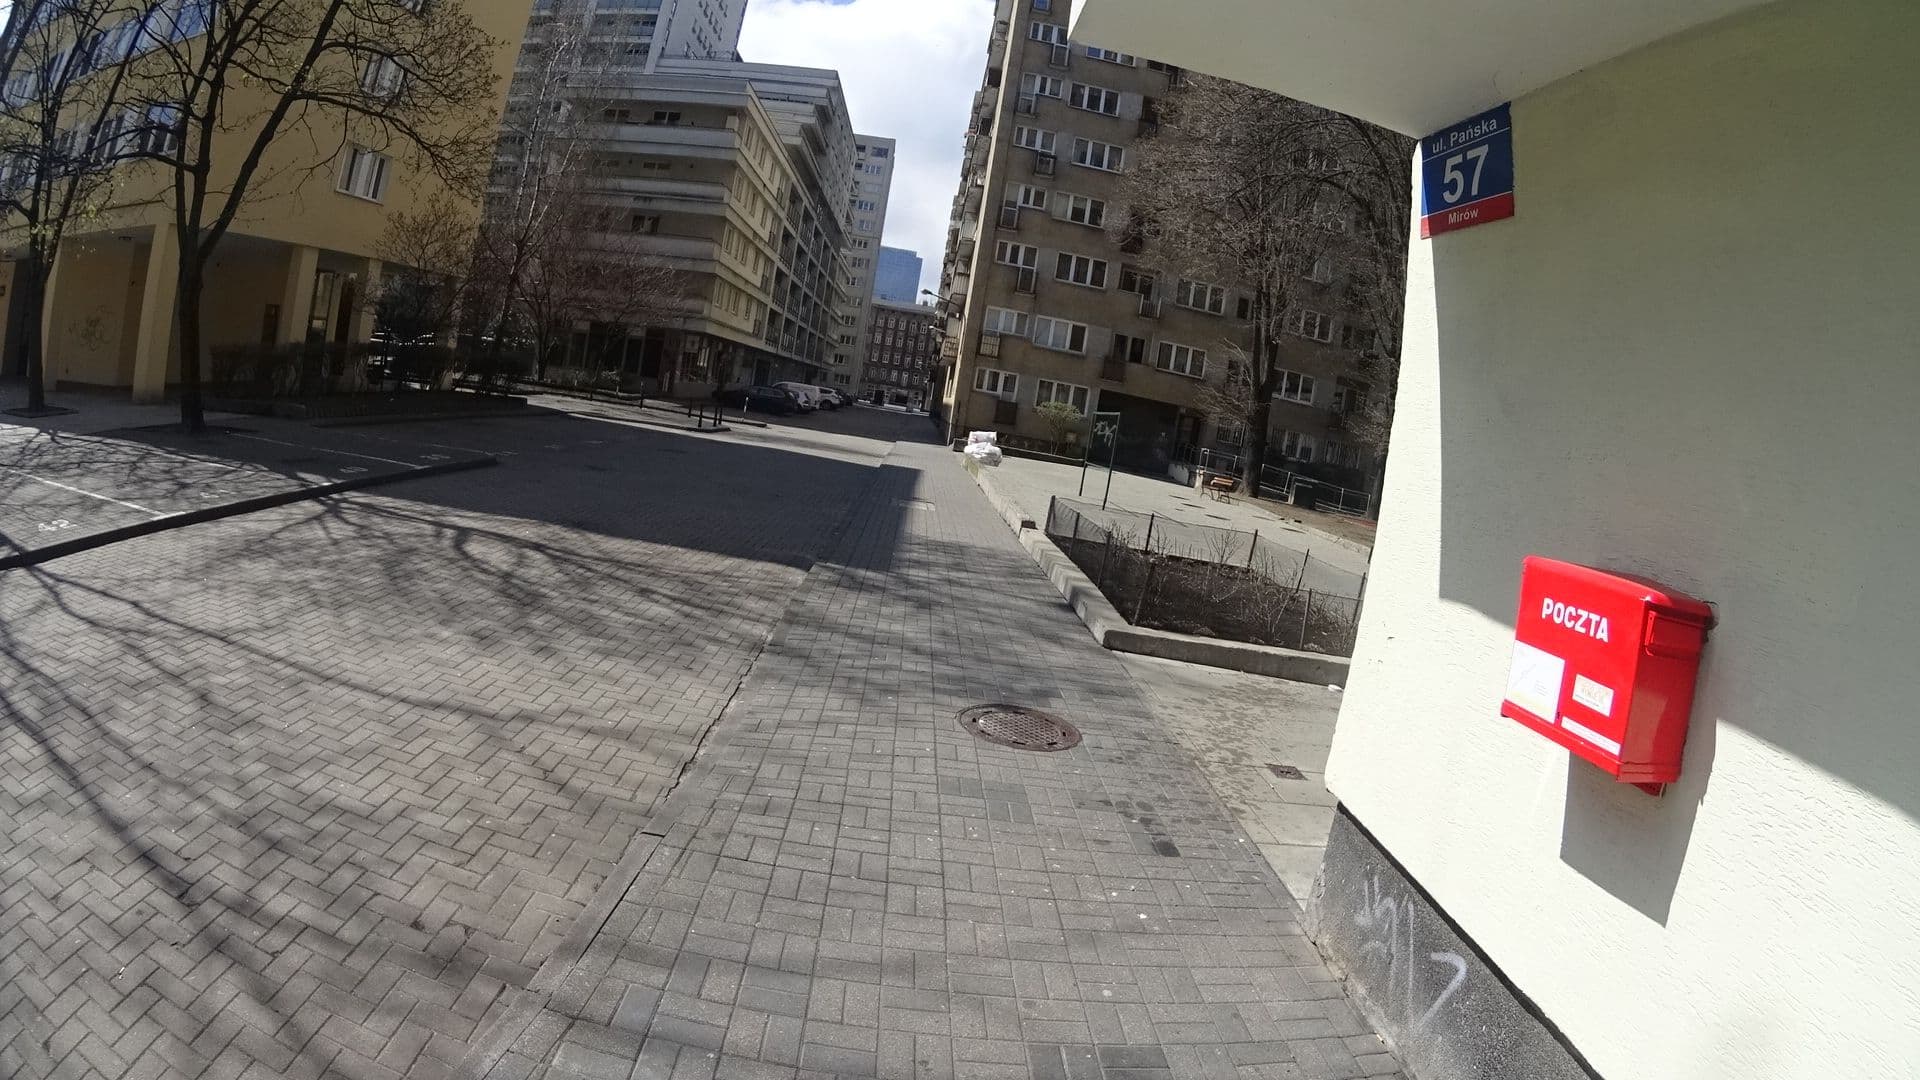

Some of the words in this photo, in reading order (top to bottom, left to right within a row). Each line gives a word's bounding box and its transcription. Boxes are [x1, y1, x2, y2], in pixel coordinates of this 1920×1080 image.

[1432, 139, 1447, 153] ul.
[1450, 118, 1497, 146] Pańska
[1442, 144, 1489, 203] 57
[1448, 208, 1479, 225] Mirów
[38, 519, 78, 532] 42
[1541, 597, 1609, 643] POCZTA
